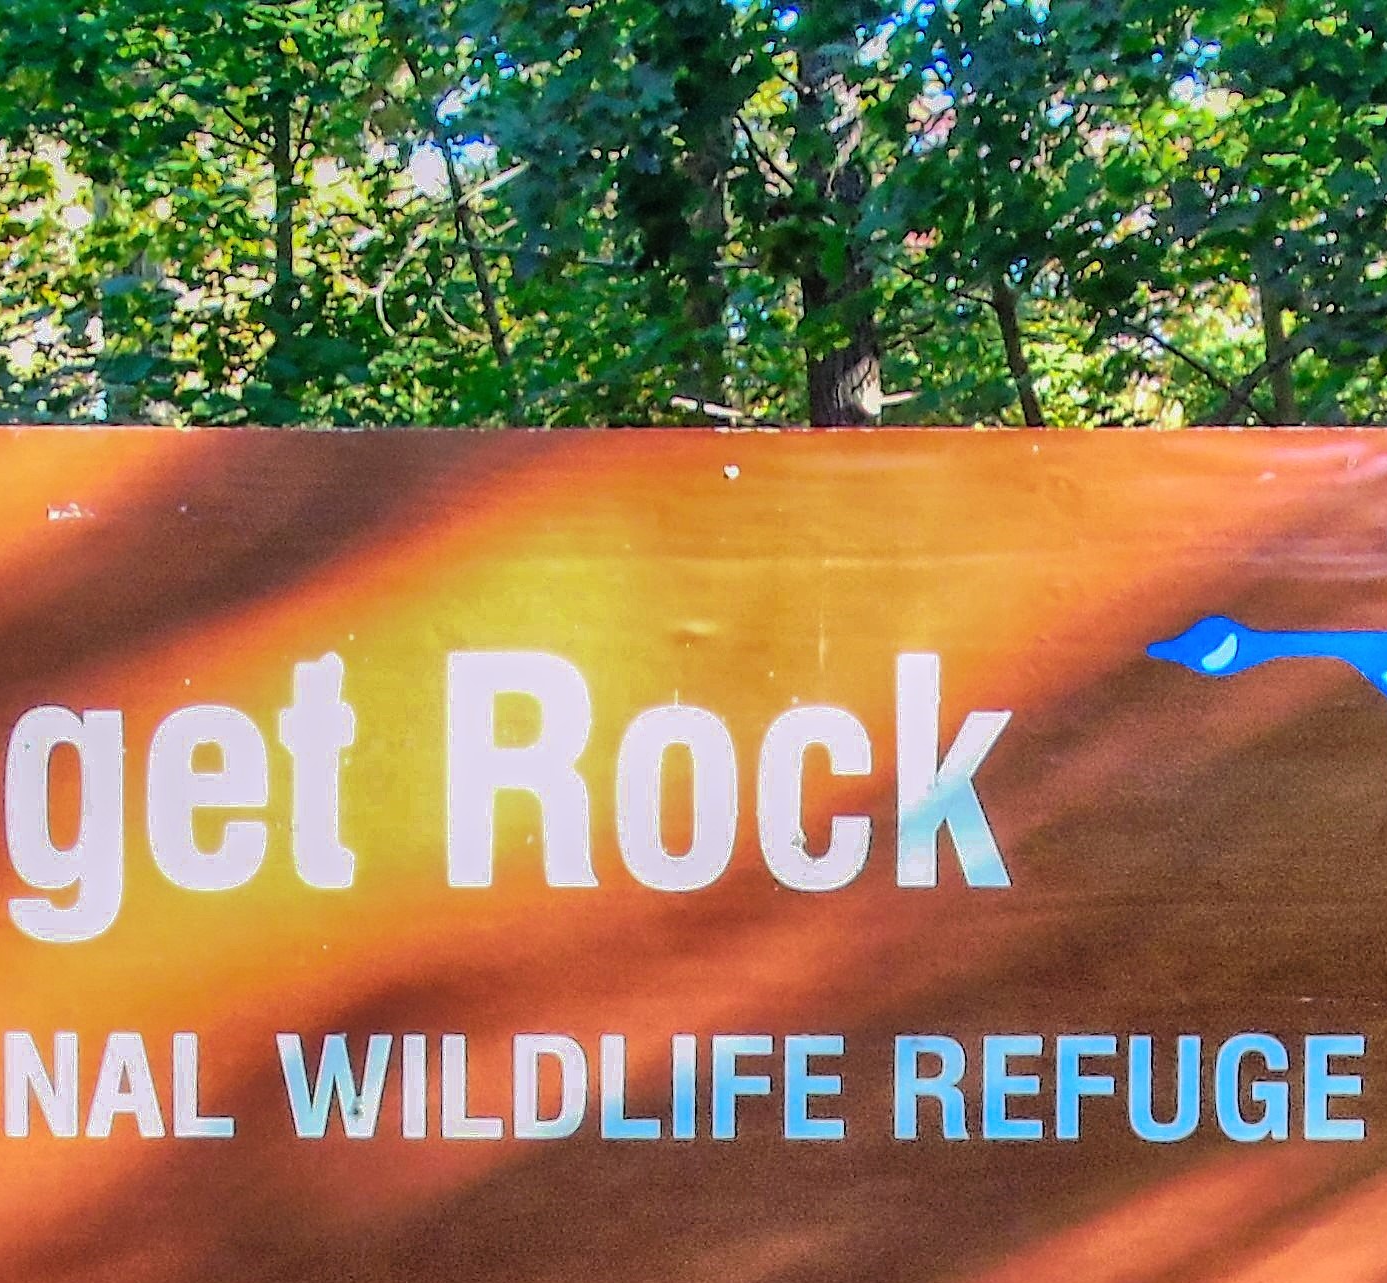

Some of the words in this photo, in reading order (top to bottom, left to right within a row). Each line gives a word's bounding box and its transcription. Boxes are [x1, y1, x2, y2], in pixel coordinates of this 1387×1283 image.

[446, 650, 1013, 892] Rock
[275, 1031, 846, 1142] WILDLIFE
[893, 1032, 1366, 1142] REFUGE
